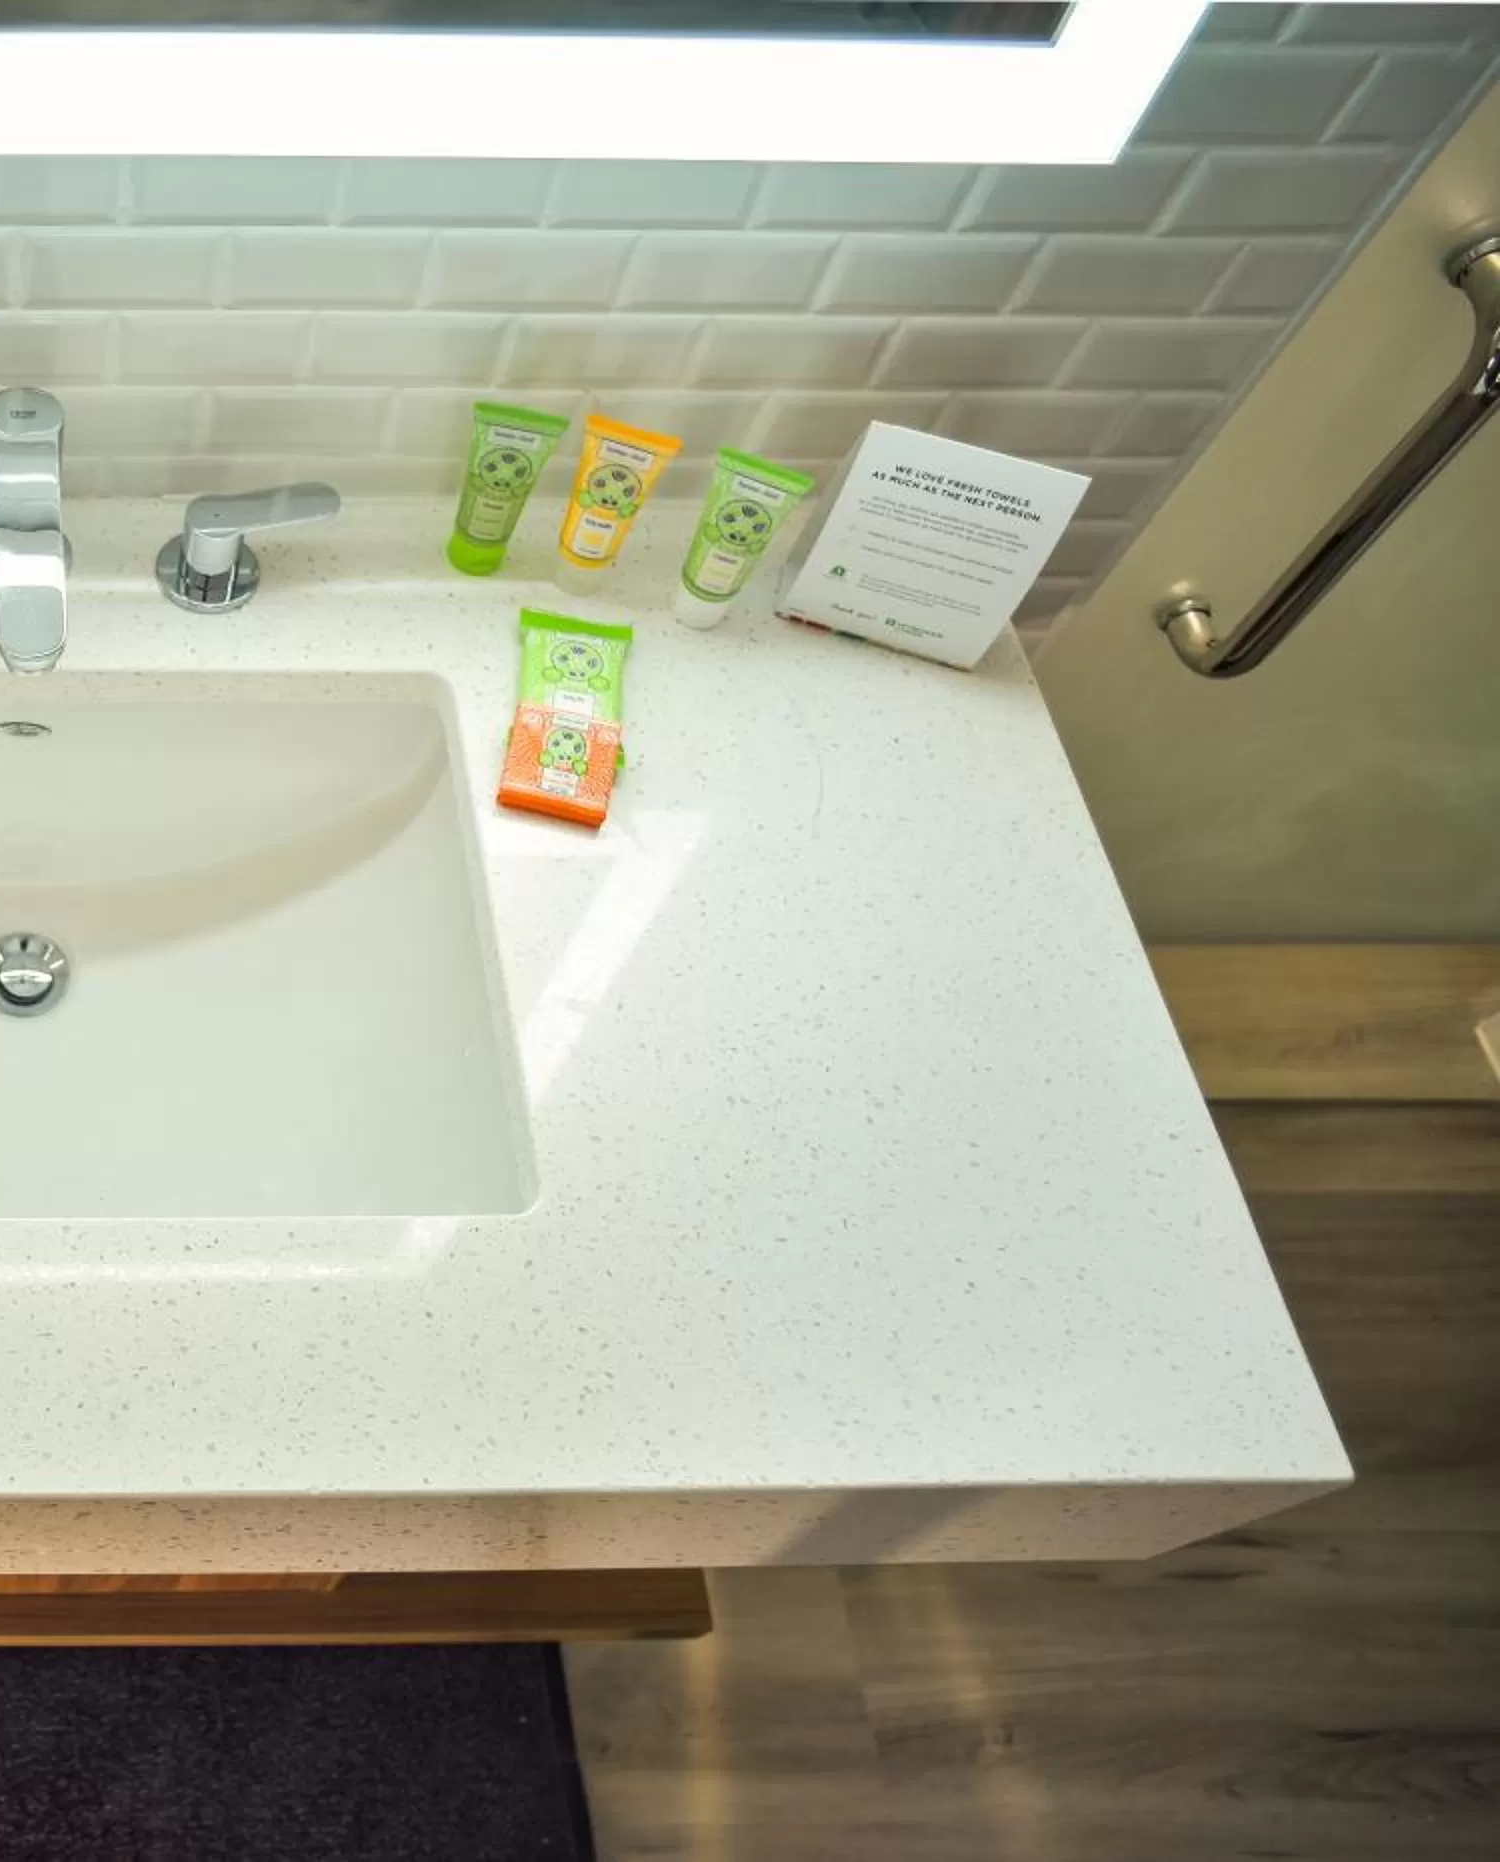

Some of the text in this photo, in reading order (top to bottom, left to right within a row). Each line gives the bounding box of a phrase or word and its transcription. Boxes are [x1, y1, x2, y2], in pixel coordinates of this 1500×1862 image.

[871, 471, 887, 481] AS
[888, 475, 920, 489] MUCH
[922, 485, 937, 495] AS
[940, 488, 963, 501] THE
[964, 495, 994, 509] NEXT
[895, 463, 1031, 508] WE LOVE FRESH TOWELS
